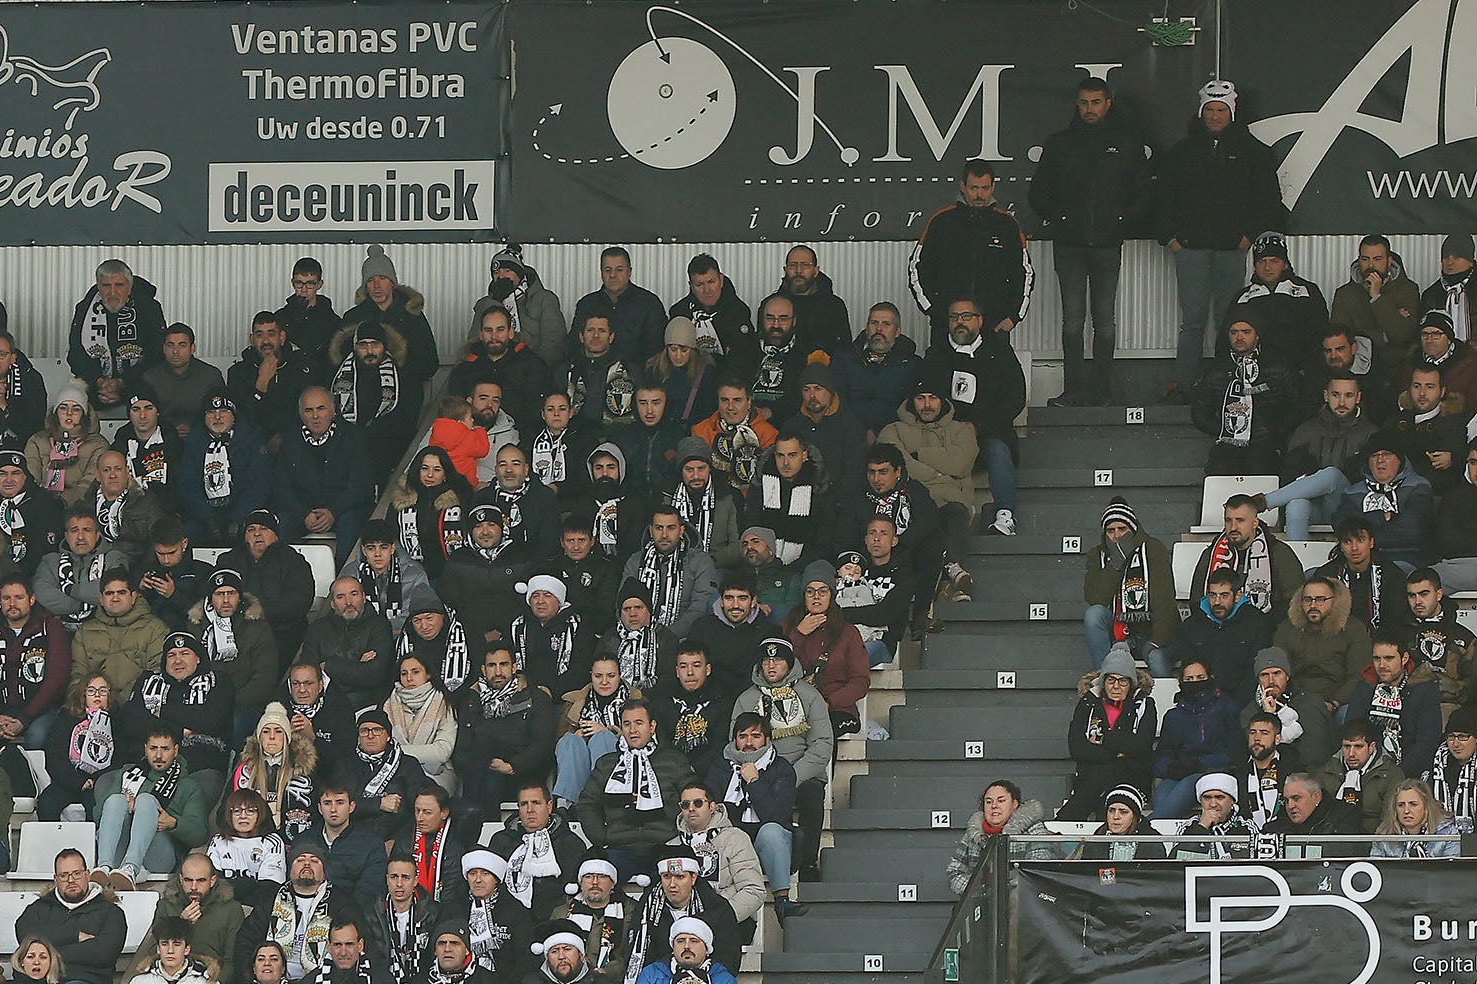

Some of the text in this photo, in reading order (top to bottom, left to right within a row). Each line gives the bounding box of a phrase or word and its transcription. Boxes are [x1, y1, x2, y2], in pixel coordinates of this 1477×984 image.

[231, 22, 476, 54] Ventanas PVC
[243, 68, 464, 99] ThermoFibra
[257, 115, 446, 140] Uw desde 0.71
[224, 169, 478, 223] deceuninck
[1129, 411, 1142, 420] 18
[1097, 473, 1110, 482] 17
[1065, 540, 1078, 548] 16
[1032, 608, 1045, 616] 15
[1000, 676, 1013, 684] 14
[968, 746, 981, 754] 13
[935, 815, 948, 823] 12
[901, 889, 913, 897] 11
[867, 958, 880, 967] 10
